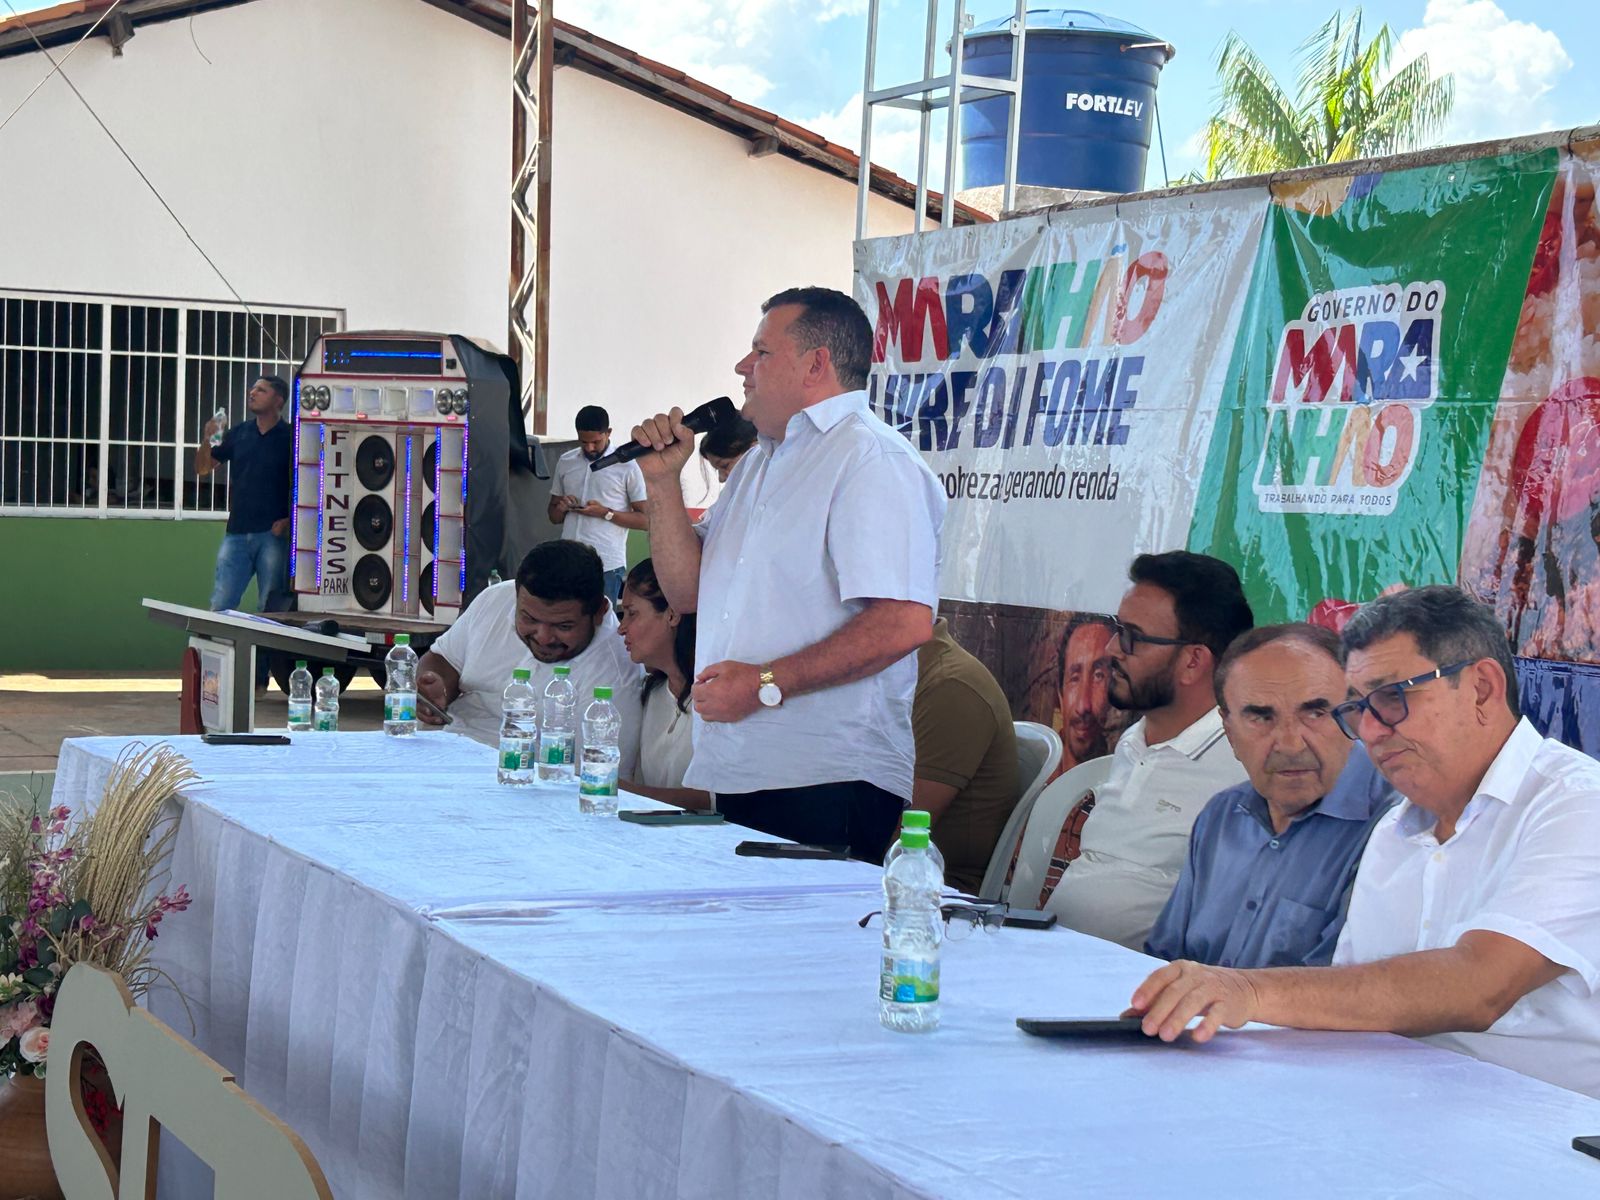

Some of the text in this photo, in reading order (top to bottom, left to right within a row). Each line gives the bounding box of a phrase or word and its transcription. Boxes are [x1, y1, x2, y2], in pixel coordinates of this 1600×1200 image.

[1066, 92, 1144, 118] FORTLEV
[1307, 290, 1439, 322] GOVERNO DO
[1023, 356, 1145, 447] FOME
[1002, 463, 1066, 504] gerando
[1068, 463, 1120, 501] renda
[1264, 493, 1392, 506] TRABALHANDO PARA TODOS
[326, 430, 350, 575] FITNESS
[323, 577, 349, 594] PARK
